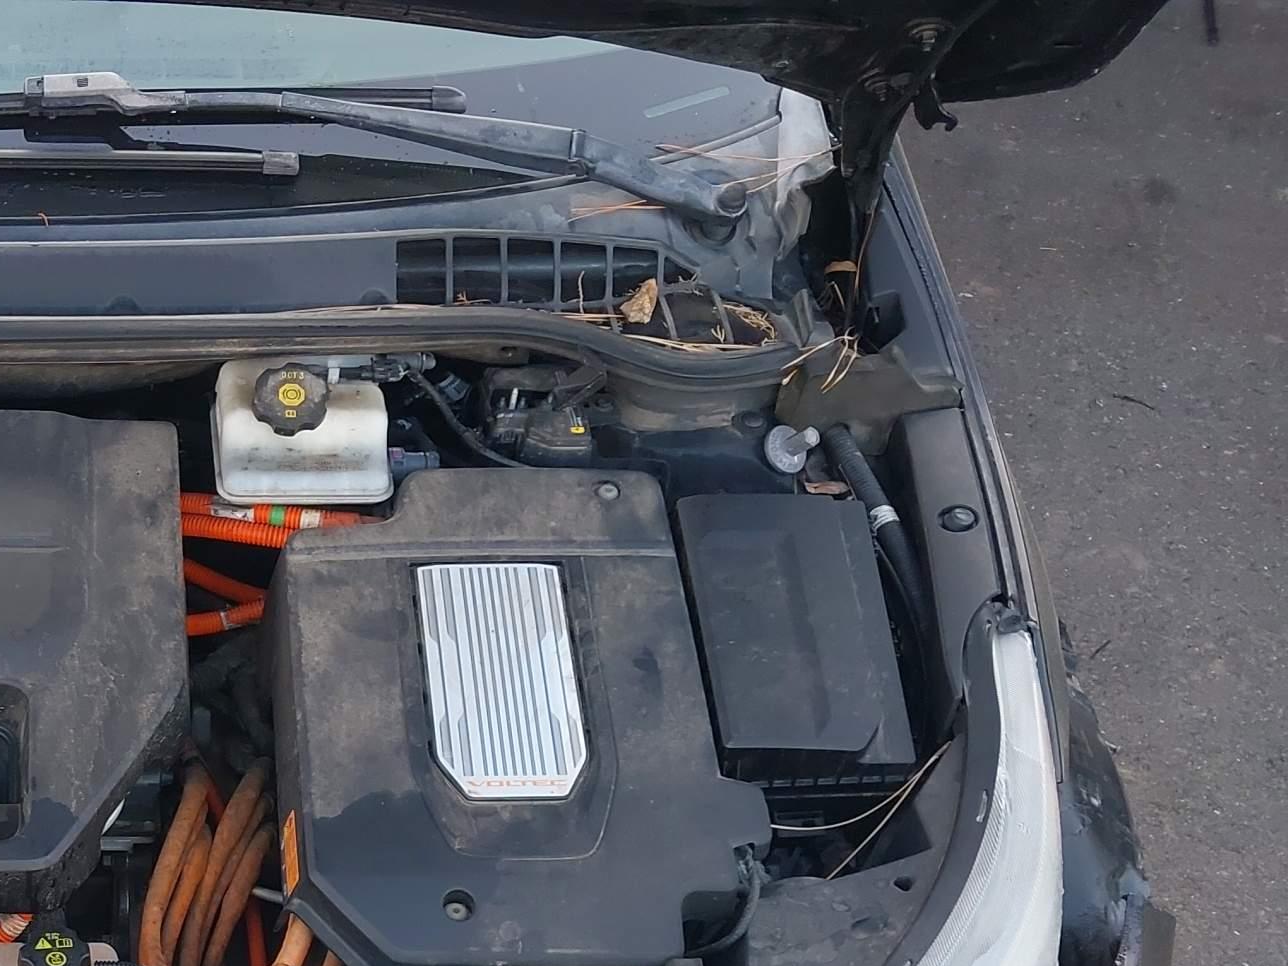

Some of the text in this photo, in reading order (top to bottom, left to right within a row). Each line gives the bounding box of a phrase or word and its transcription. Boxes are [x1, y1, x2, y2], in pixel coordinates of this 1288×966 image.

[281, 371, 305, 380] DOT 3
[467, 779, 568, 787] VOLTEC
